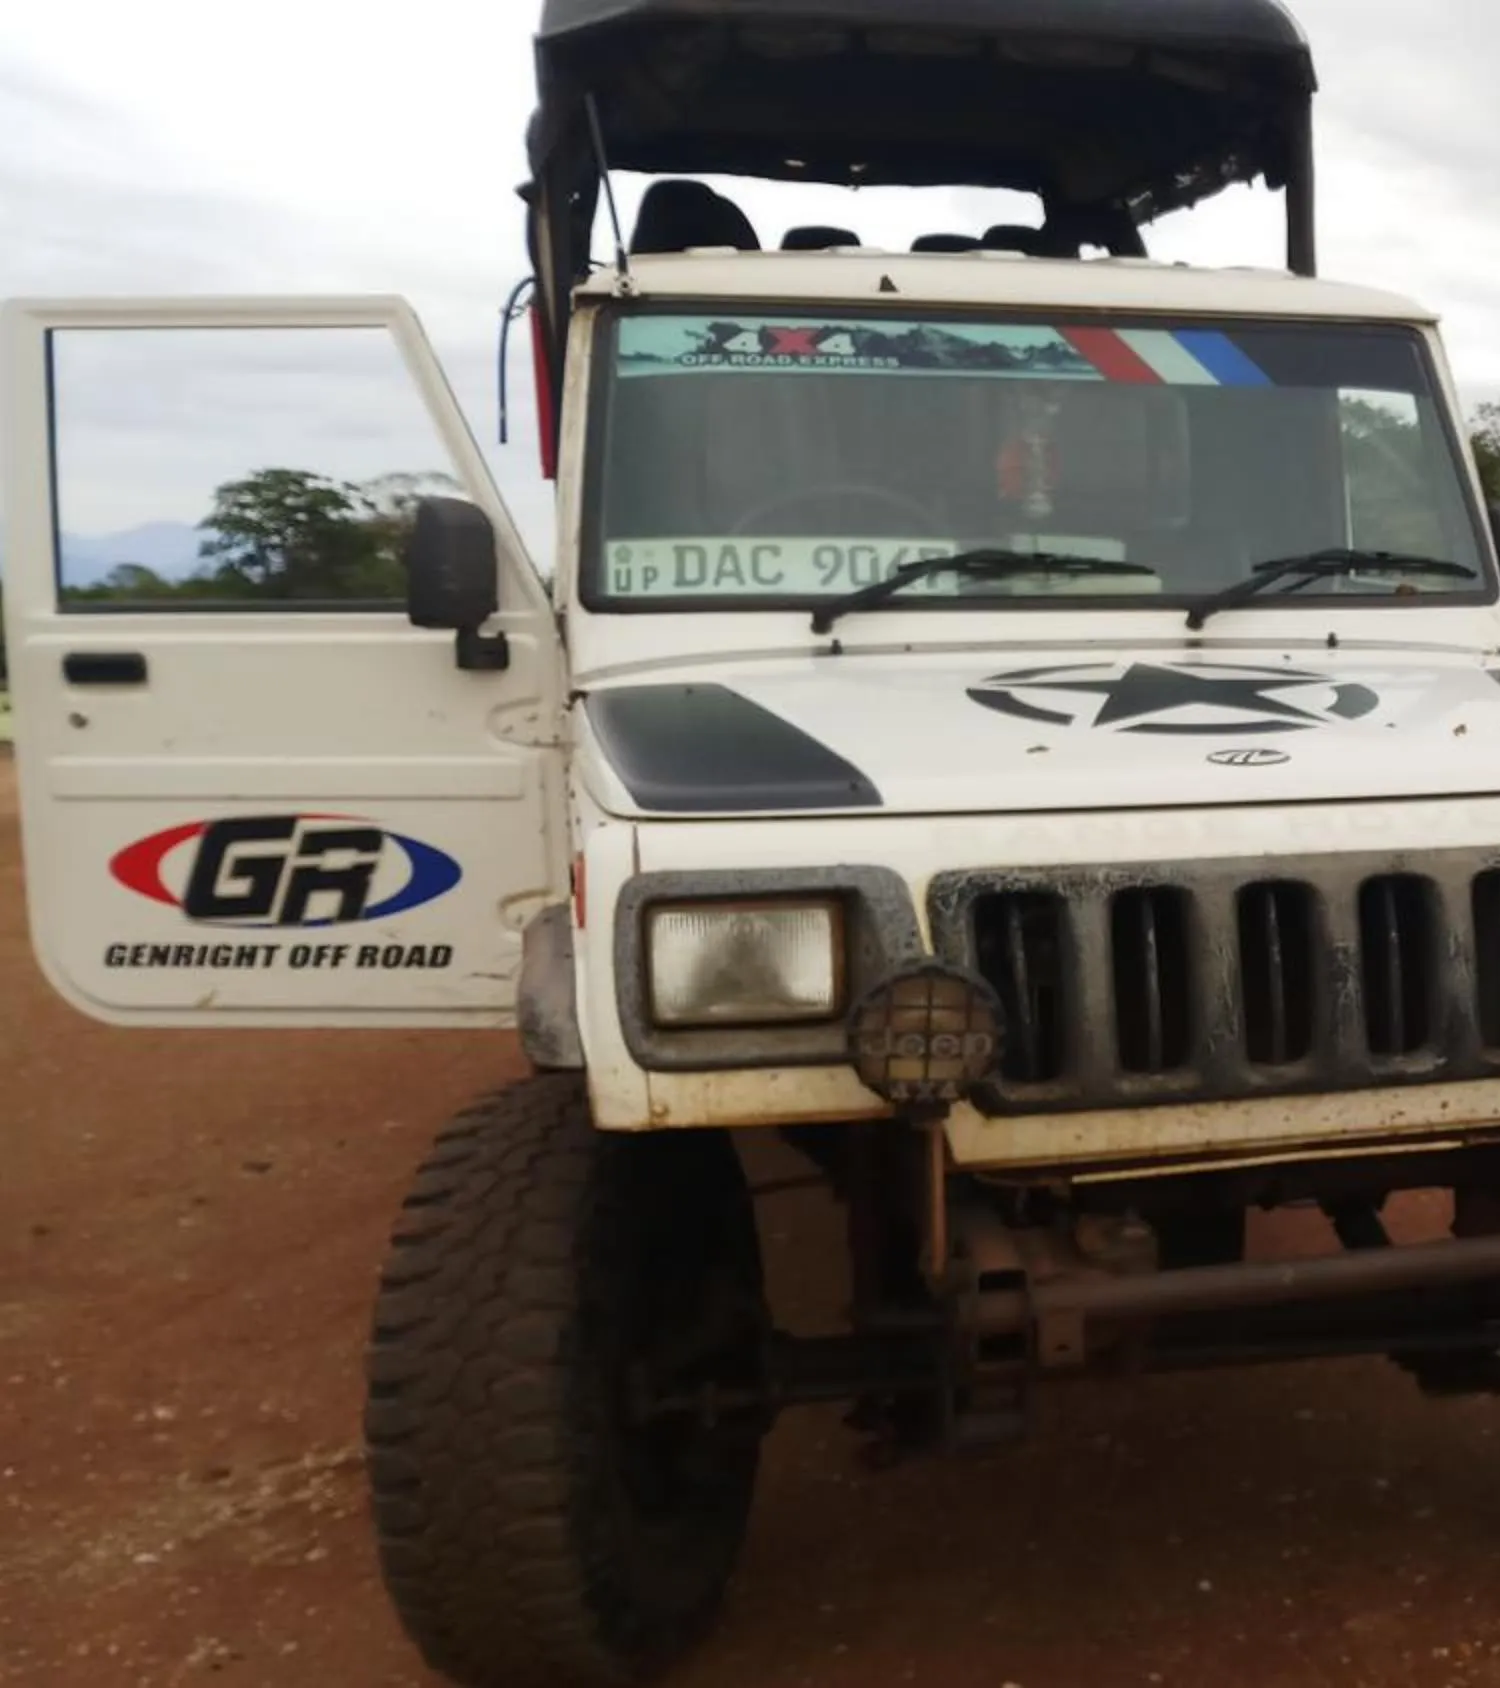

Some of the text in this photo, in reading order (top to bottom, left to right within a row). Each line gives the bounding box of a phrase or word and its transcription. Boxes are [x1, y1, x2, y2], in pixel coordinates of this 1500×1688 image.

[681, 354, 900, 368] OFF ROAD EXPRESS
[672, 544, 786, 588] DAC
[184, 815, 384, 925] GR
[104, 943, 454, 969] GENRIGHT OFF ROAD
[860, 1026, 993, 1060] Jeep
